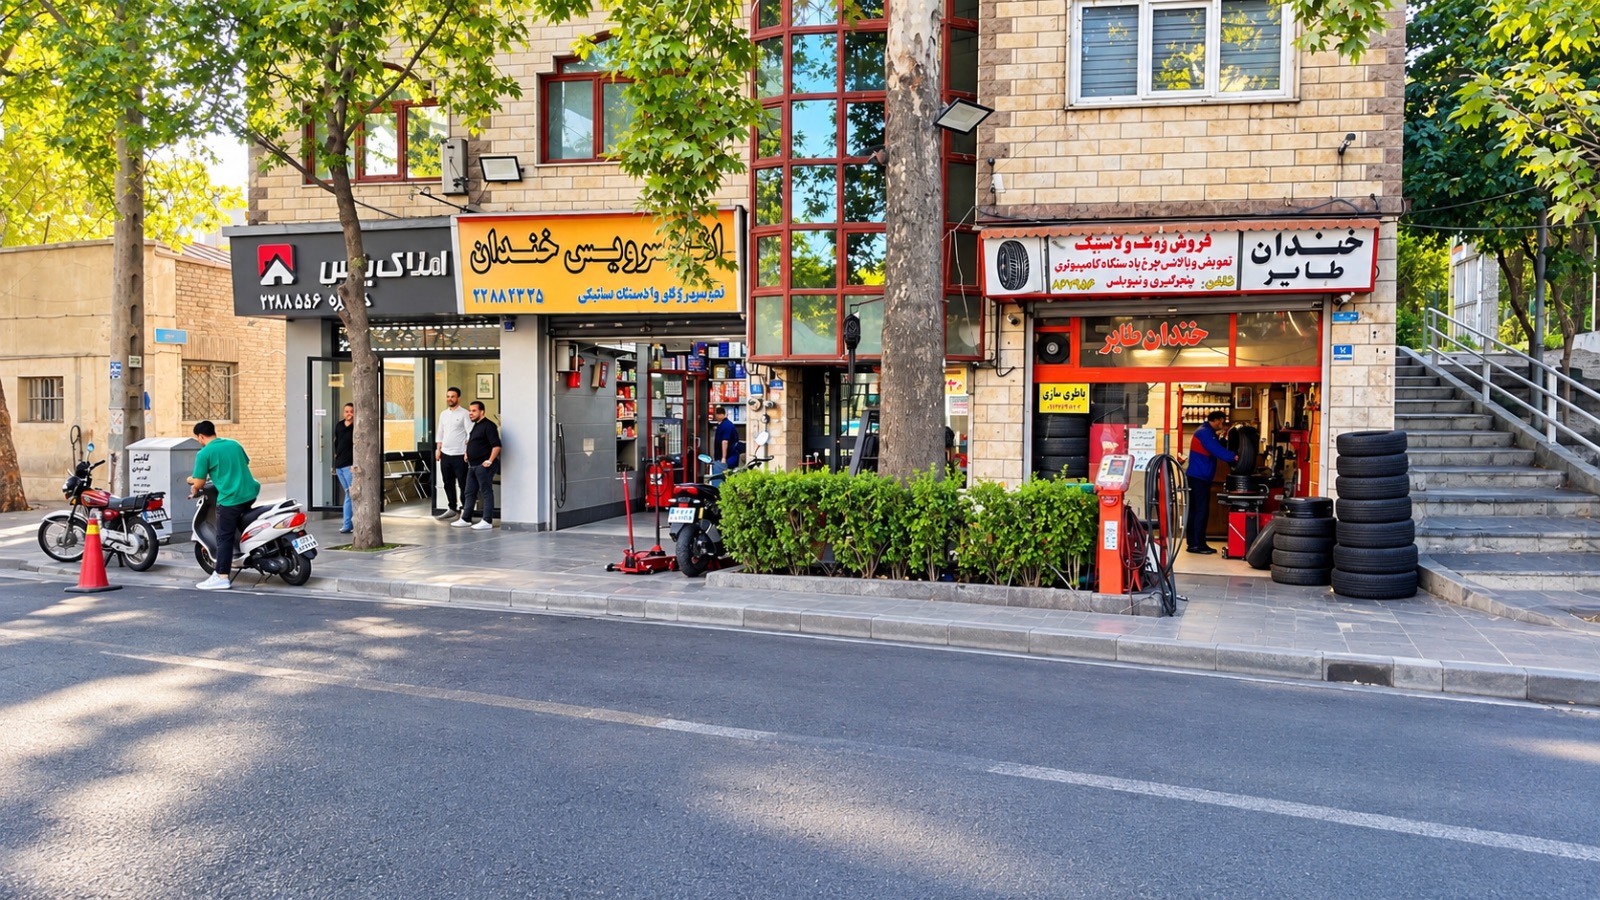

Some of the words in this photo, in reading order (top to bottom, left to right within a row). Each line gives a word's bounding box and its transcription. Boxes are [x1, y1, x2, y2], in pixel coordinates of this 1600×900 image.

[470, 227, 559, 274] خندان
[1170, 234, 1211, 253] فروش
[1251, 228, 1364, 264] خندان
[1198, 256, 1232, 270] تعویض
[1263, 260, 1344, 287] طایر
[1142, 320, 1209, 351] خندان
